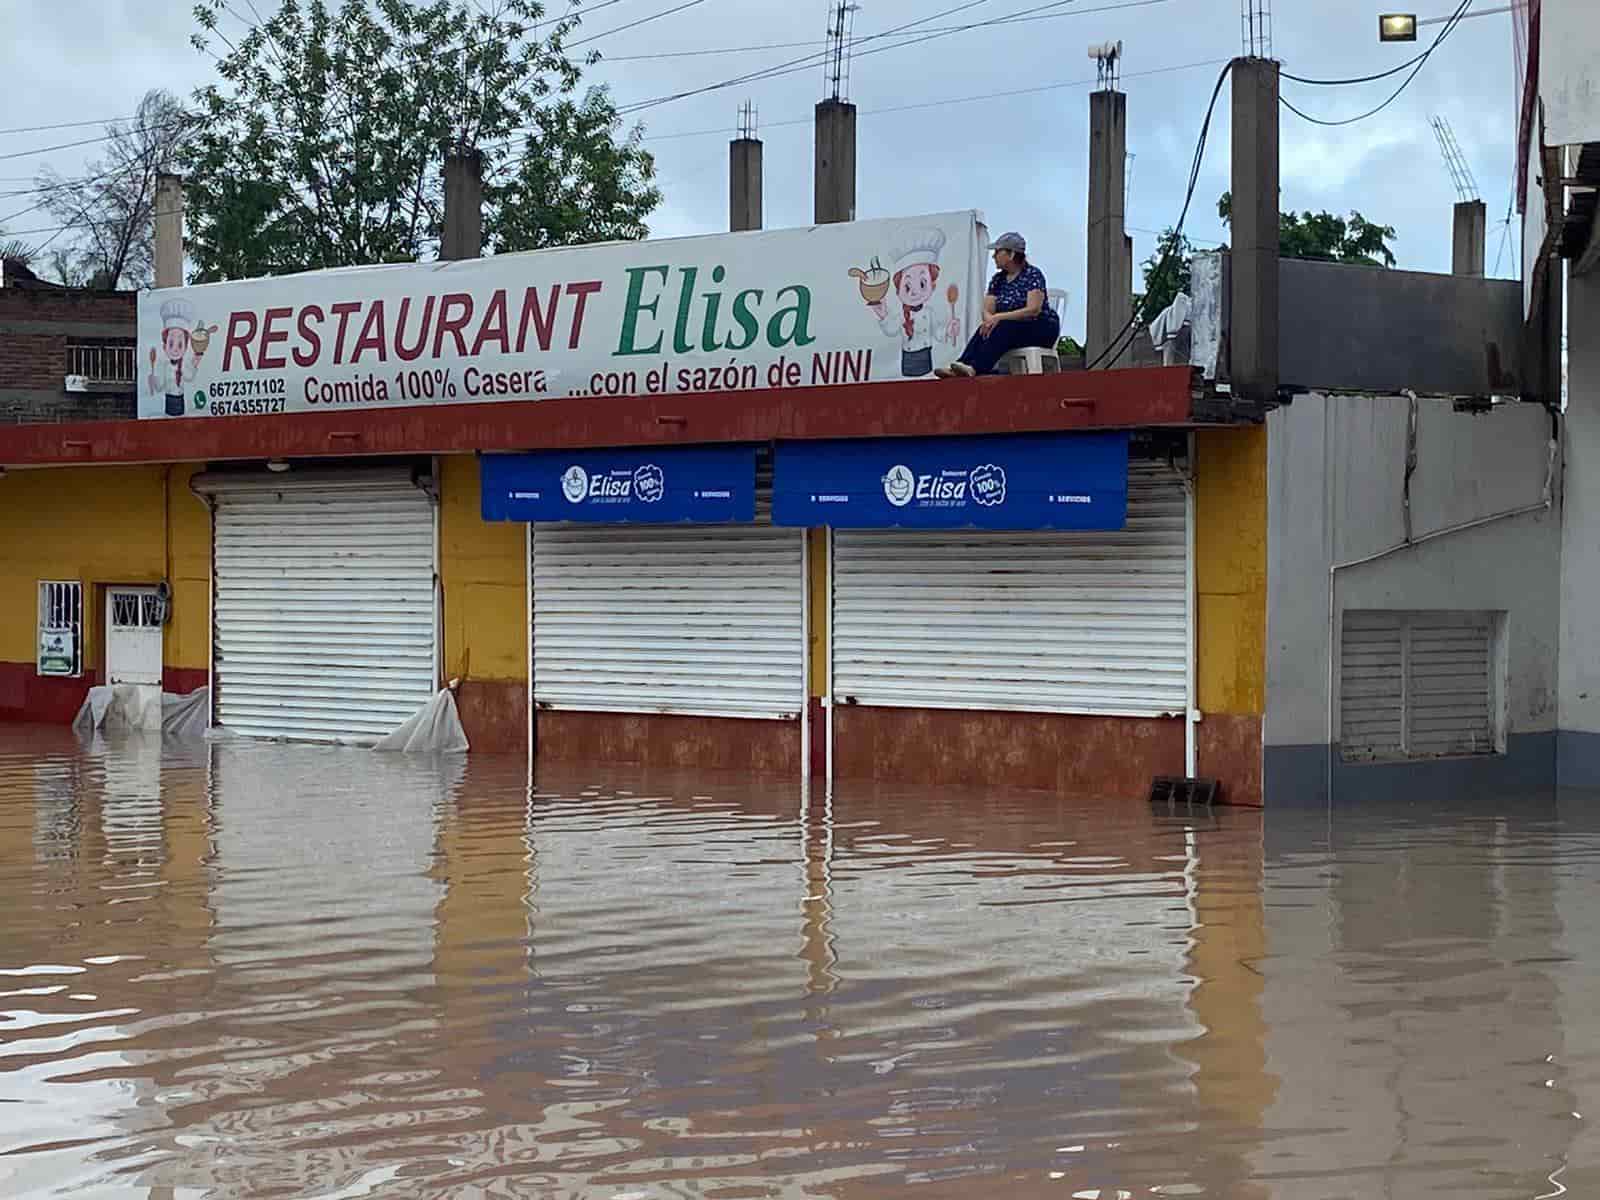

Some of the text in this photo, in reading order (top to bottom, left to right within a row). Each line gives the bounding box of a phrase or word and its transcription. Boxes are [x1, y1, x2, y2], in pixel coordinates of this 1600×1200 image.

[221, 264, 817, 372] RESTAURANT Elisa
[209, 378, 286, 398] 6672371102
[303, 371, 388, 405] Comida
[394, 368, 457, 400] 100%
[463, 365, 548, 397] Casera
[647, 363, 669, 394] el
[676, 357, 758, 392] sazón
[767, 355, 801, 388] de
[811, 348, 873, 385] NINI
[209, 397, 287, 416] 6674355727
[588, 474, 632, 497] Elisa
[915, 474, 967, 499] Elisa
